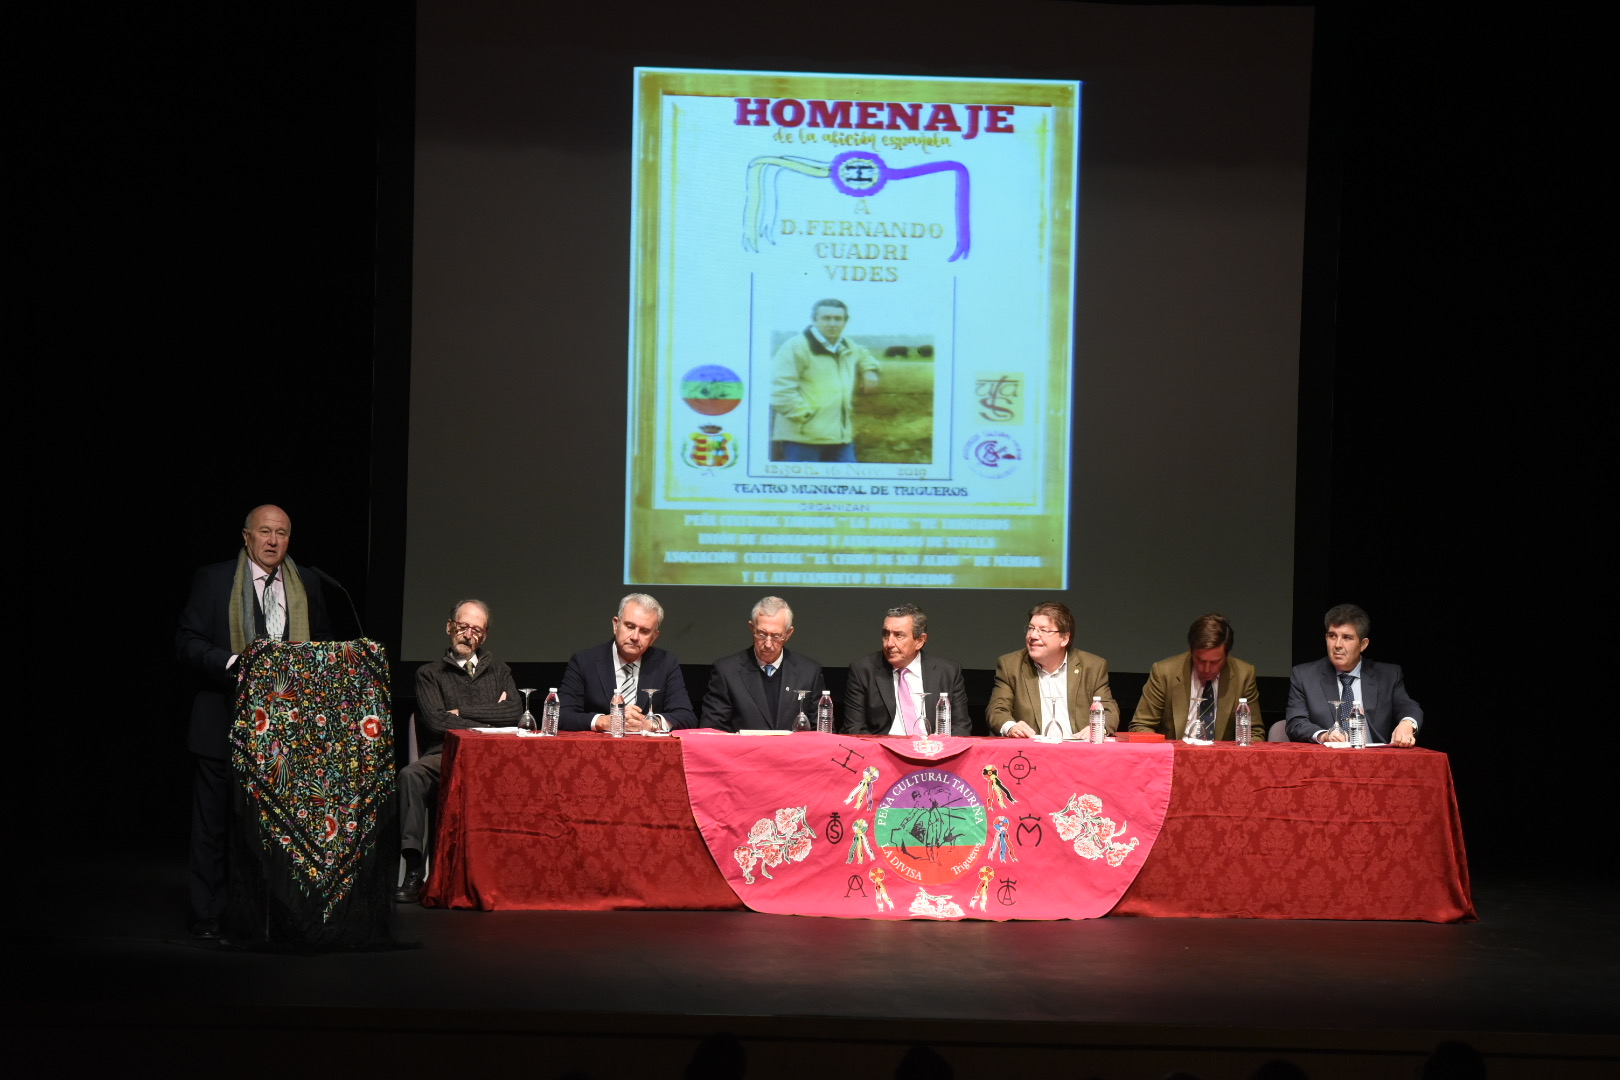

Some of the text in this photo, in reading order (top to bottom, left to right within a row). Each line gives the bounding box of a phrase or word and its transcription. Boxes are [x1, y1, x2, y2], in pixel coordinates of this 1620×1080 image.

[734, 98, 1015, 140] HOMENAJE
[773, 127, 792, 143] de
[800, 128, 817, 144] la
[854, 199, 871, 215] A
[815, 242, 910, 261] CUADRI
[824, 265, 898, 282] VIDES
[733, 483, 969, 497] TEATRO MUNICIPAL DE TRIGUEROS
[877, 772, 984, 826] PEÑA CULTURAL TAURINA
[880, 842, 983, 881] LA DIVISA Trigueros
